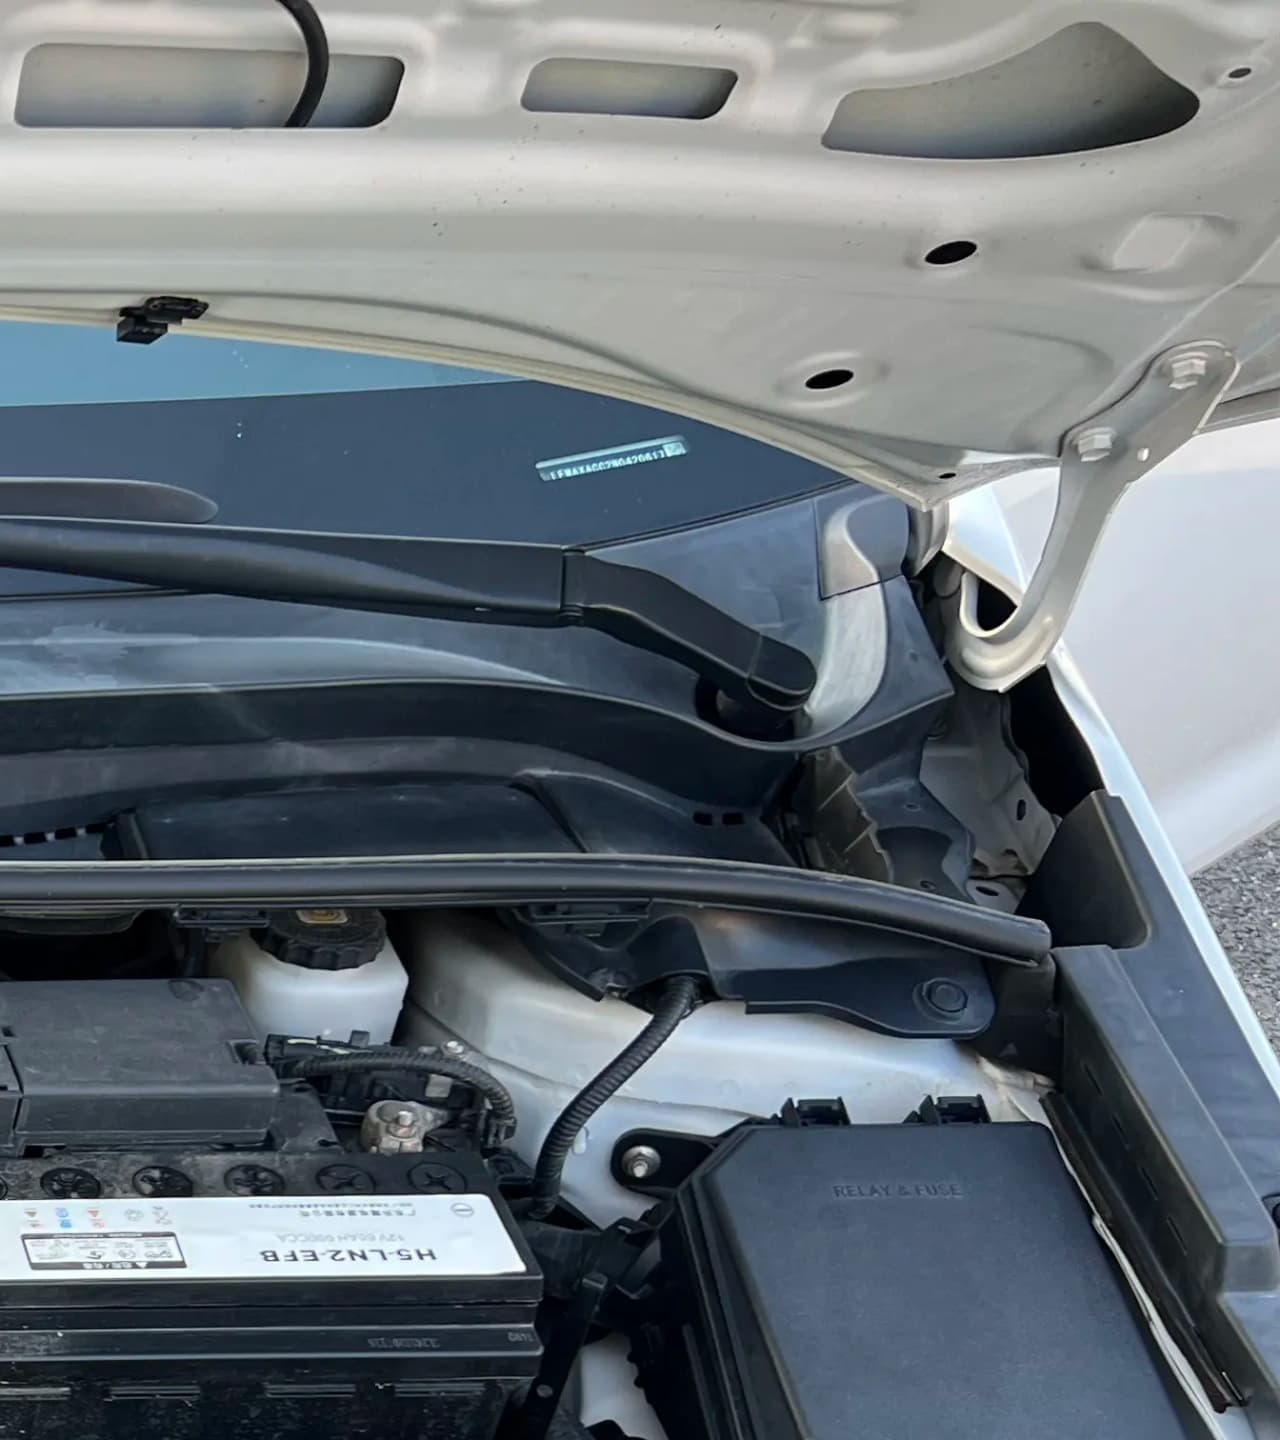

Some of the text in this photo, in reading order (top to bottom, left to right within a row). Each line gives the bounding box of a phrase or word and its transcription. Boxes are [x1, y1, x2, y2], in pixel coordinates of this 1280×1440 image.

[832, 1183, 964, 1198] RELAY & FUSE
[260, 1249, 436, 1263] H5-LN2-EFB
